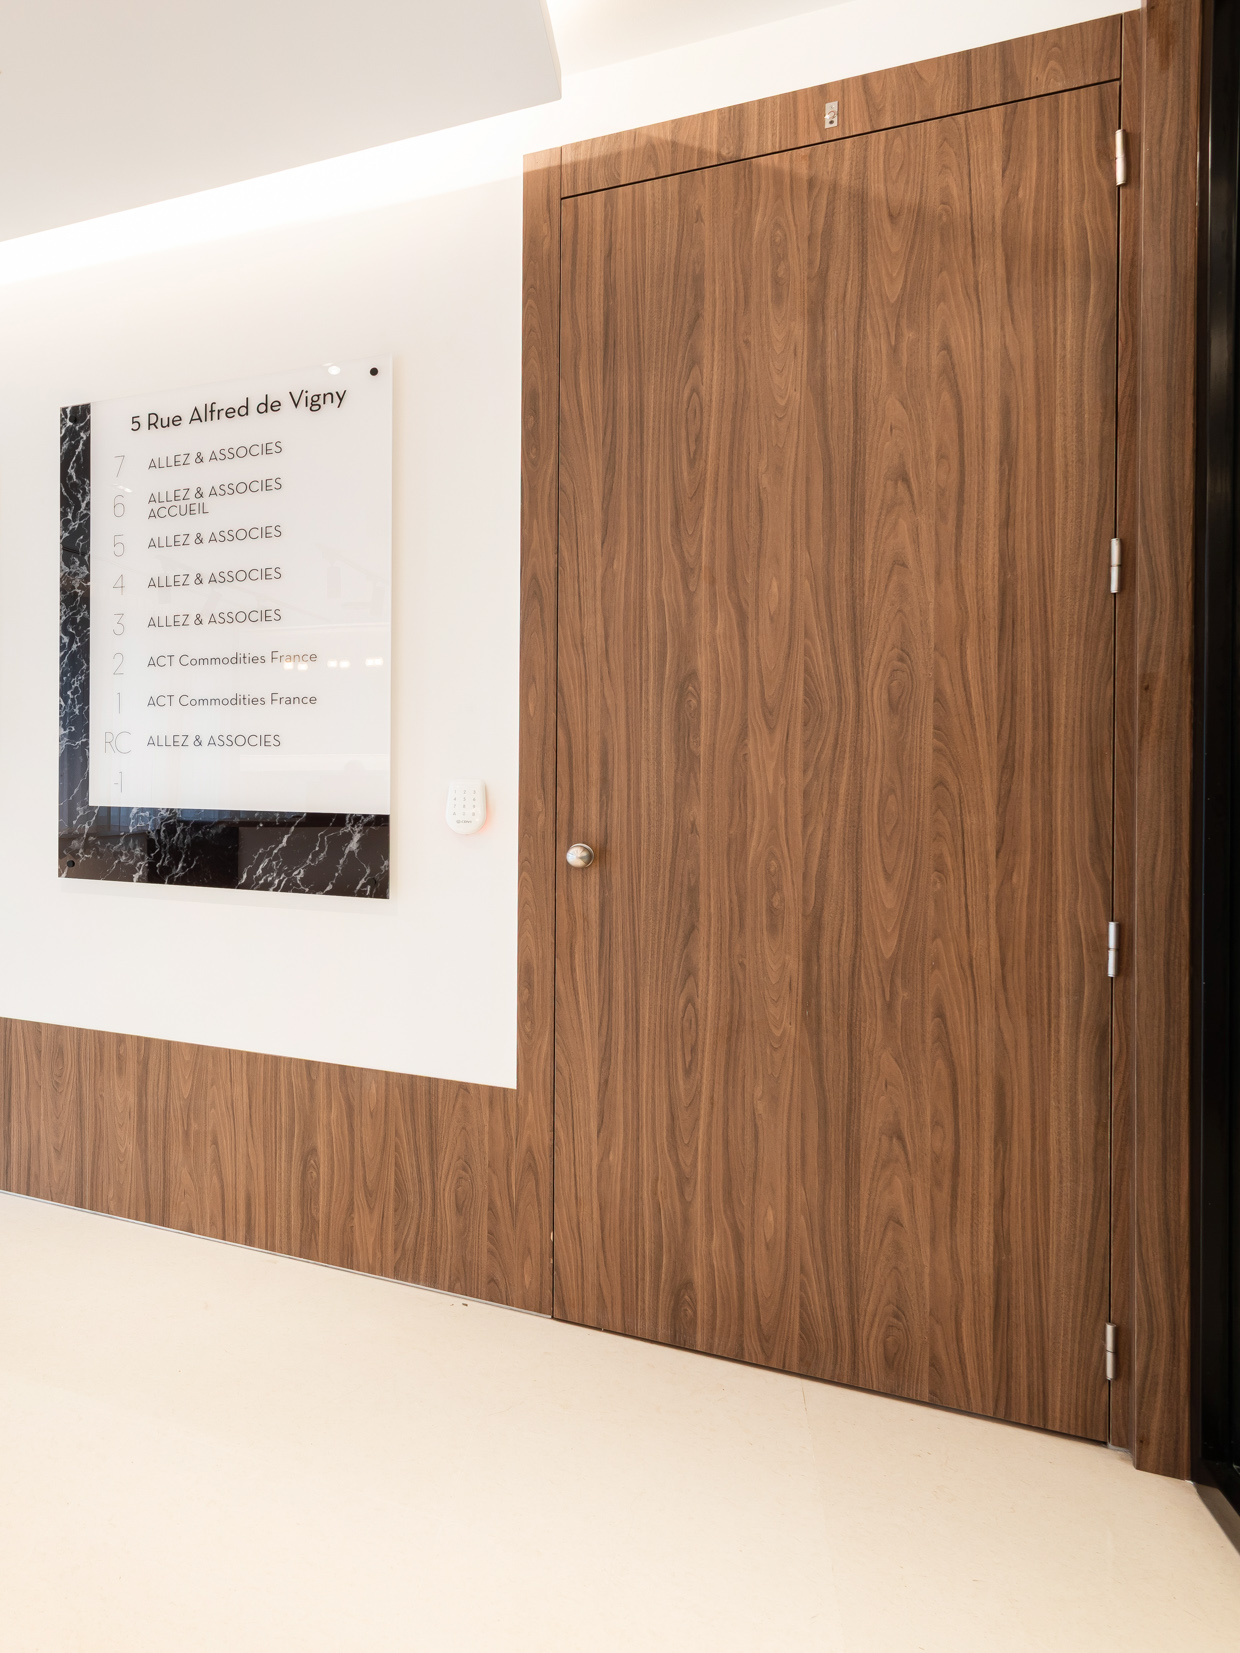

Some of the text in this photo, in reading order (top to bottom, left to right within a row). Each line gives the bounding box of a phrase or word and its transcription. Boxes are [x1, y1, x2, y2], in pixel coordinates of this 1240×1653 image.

[131, 389, 348, 432] 5 Rue Alfred de Vigny
[113, 441, 283, 478] 7 ALLEZ & ASSOCIES
[113, 477, 283, 518] 6 ALLEZ & ASSOCIES
[148, 502, 209, 520] ACCUEIL
[113, 524, 282, 557] 5 ALLEZ & ASSOCIES
[112, 567, 282, 596] 4 ALLEZ & ASSOCIES
[112, 609, 282, 636] 3 ALLEZ & ASSOCIES
[112, 651, 318, 675] 2 ACT Commodities France
[147, 695, 175, 707] ACT
[179, 693, 266, 706] Commodities
[270, 693, 317, 705] France
[104, 731, 281, 754] RC ALLEZ & ASSOCIES
